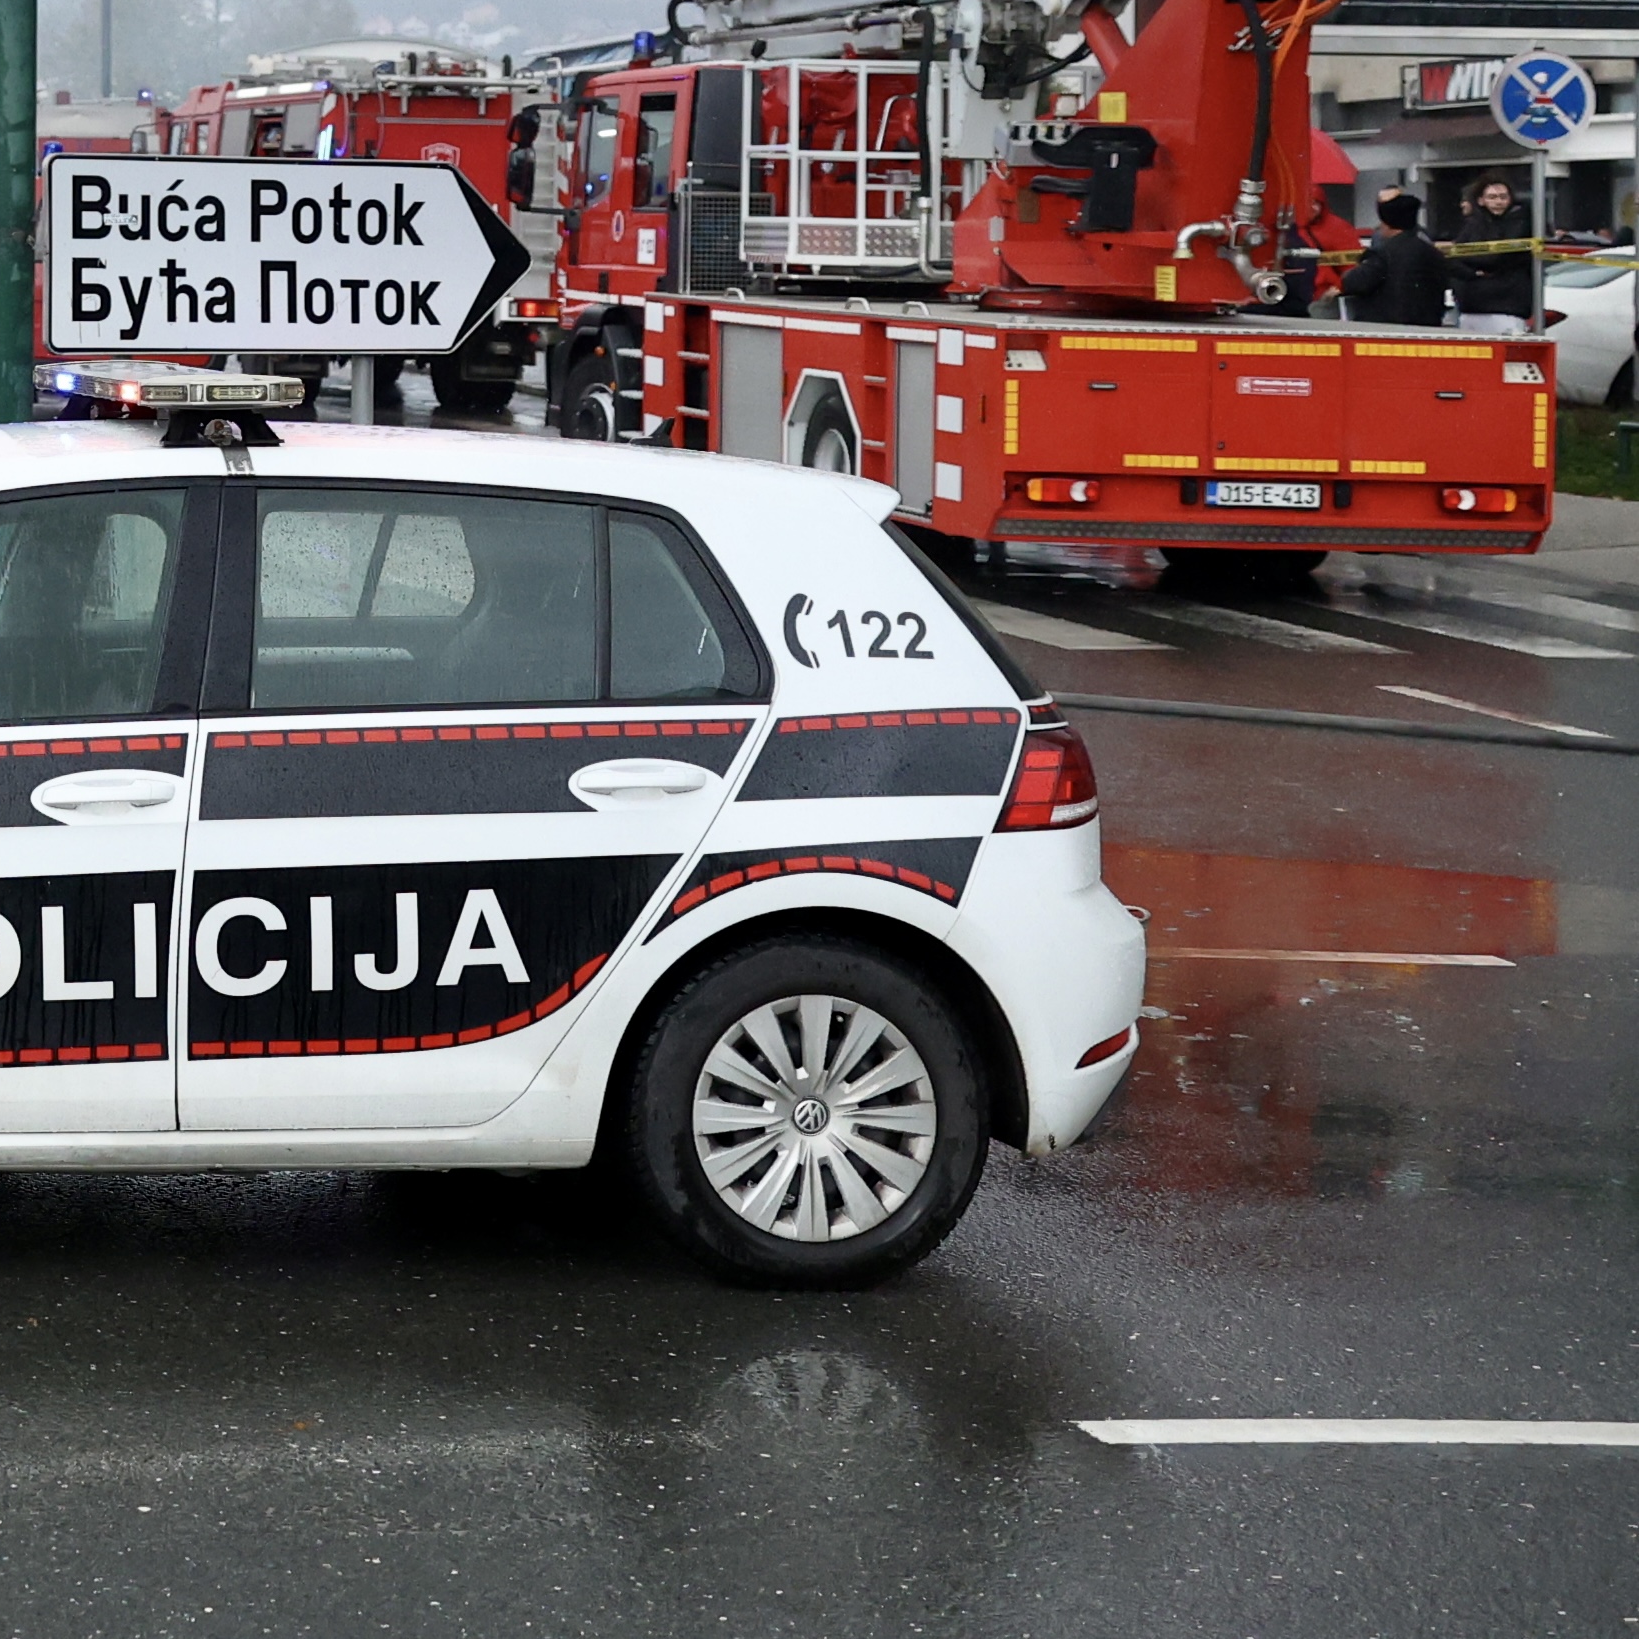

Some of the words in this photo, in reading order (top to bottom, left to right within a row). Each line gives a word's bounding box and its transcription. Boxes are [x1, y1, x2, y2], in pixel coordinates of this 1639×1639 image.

[71, 174, 226, 242] Buća
[250, 178, 426, 247] Potok
[71, 257, 236, 341] Бућа
[259, 260, 442, 327] Поток
[1220, 485, 1317, 505] J15-E-413
[826, 609, 935, 660] 122
